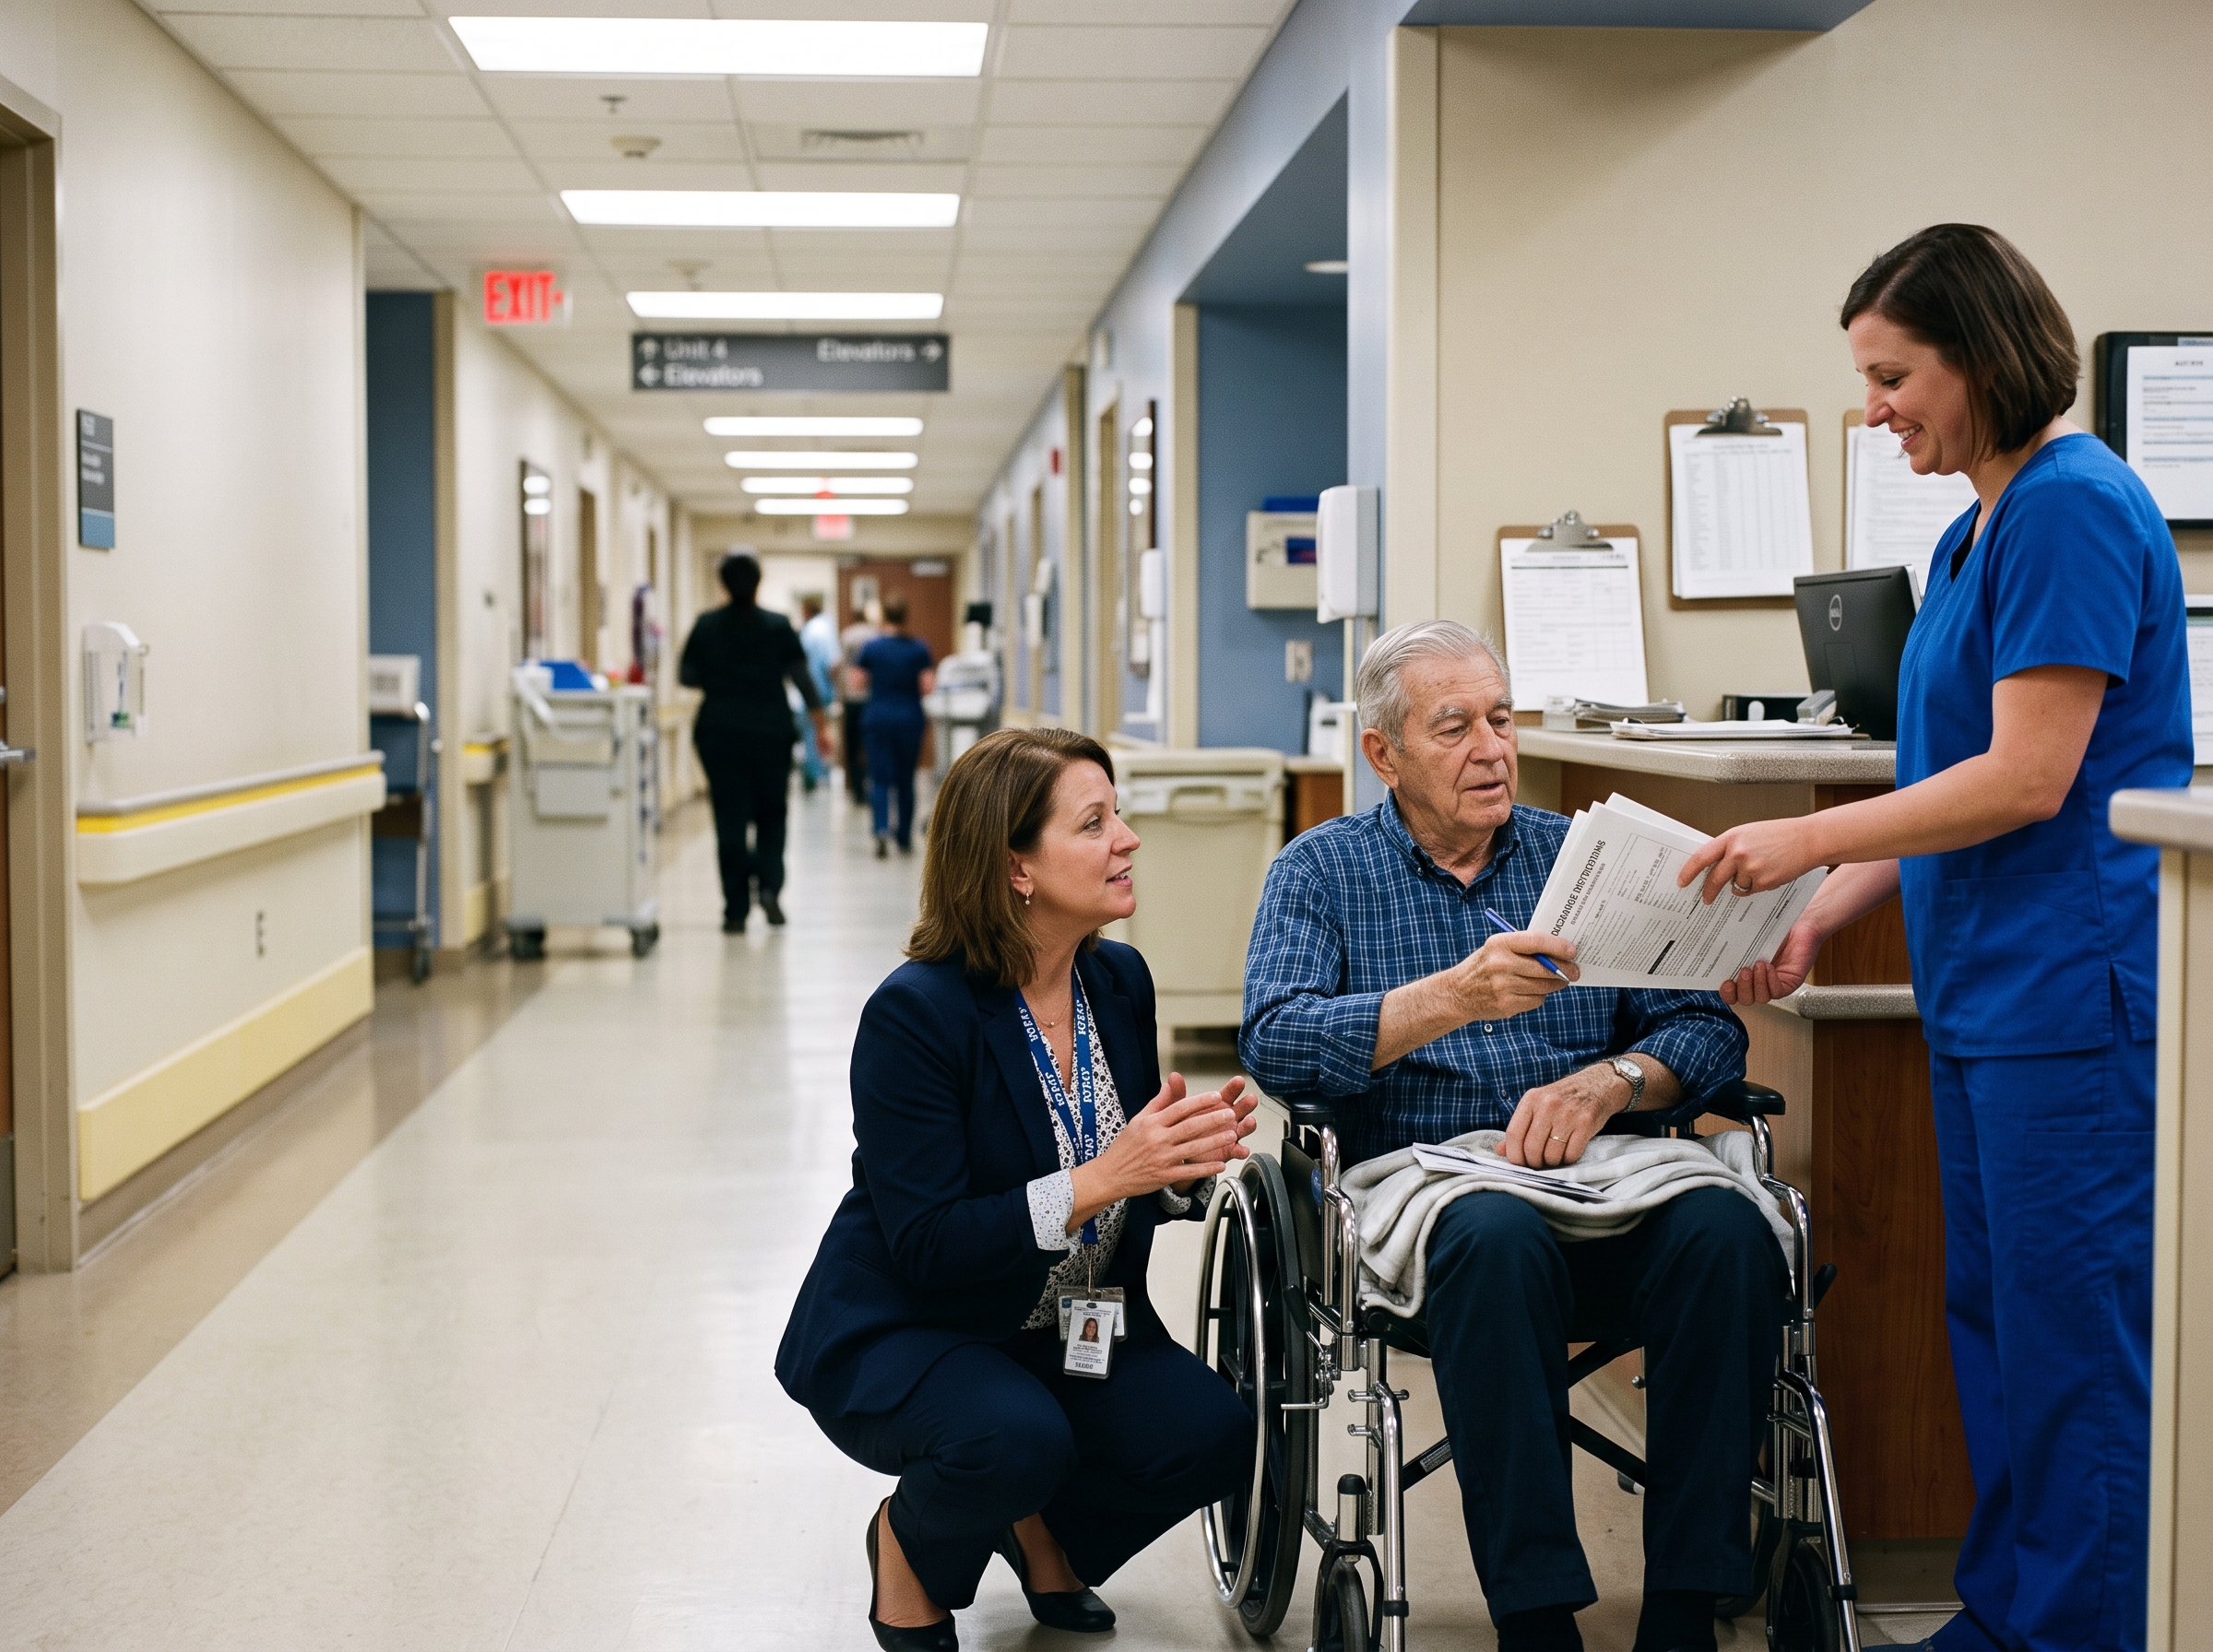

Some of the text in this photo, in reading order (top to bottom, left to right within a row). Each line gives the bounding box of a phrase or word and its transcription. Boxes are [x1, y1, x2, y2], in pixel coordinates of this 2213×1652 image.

[484, 270, 556, 324] EXIT
[663, 338, 728, 360] Unit 4
[817, 338, 915, 361] Elevators
[664, 362, 763, 386] Elevators
